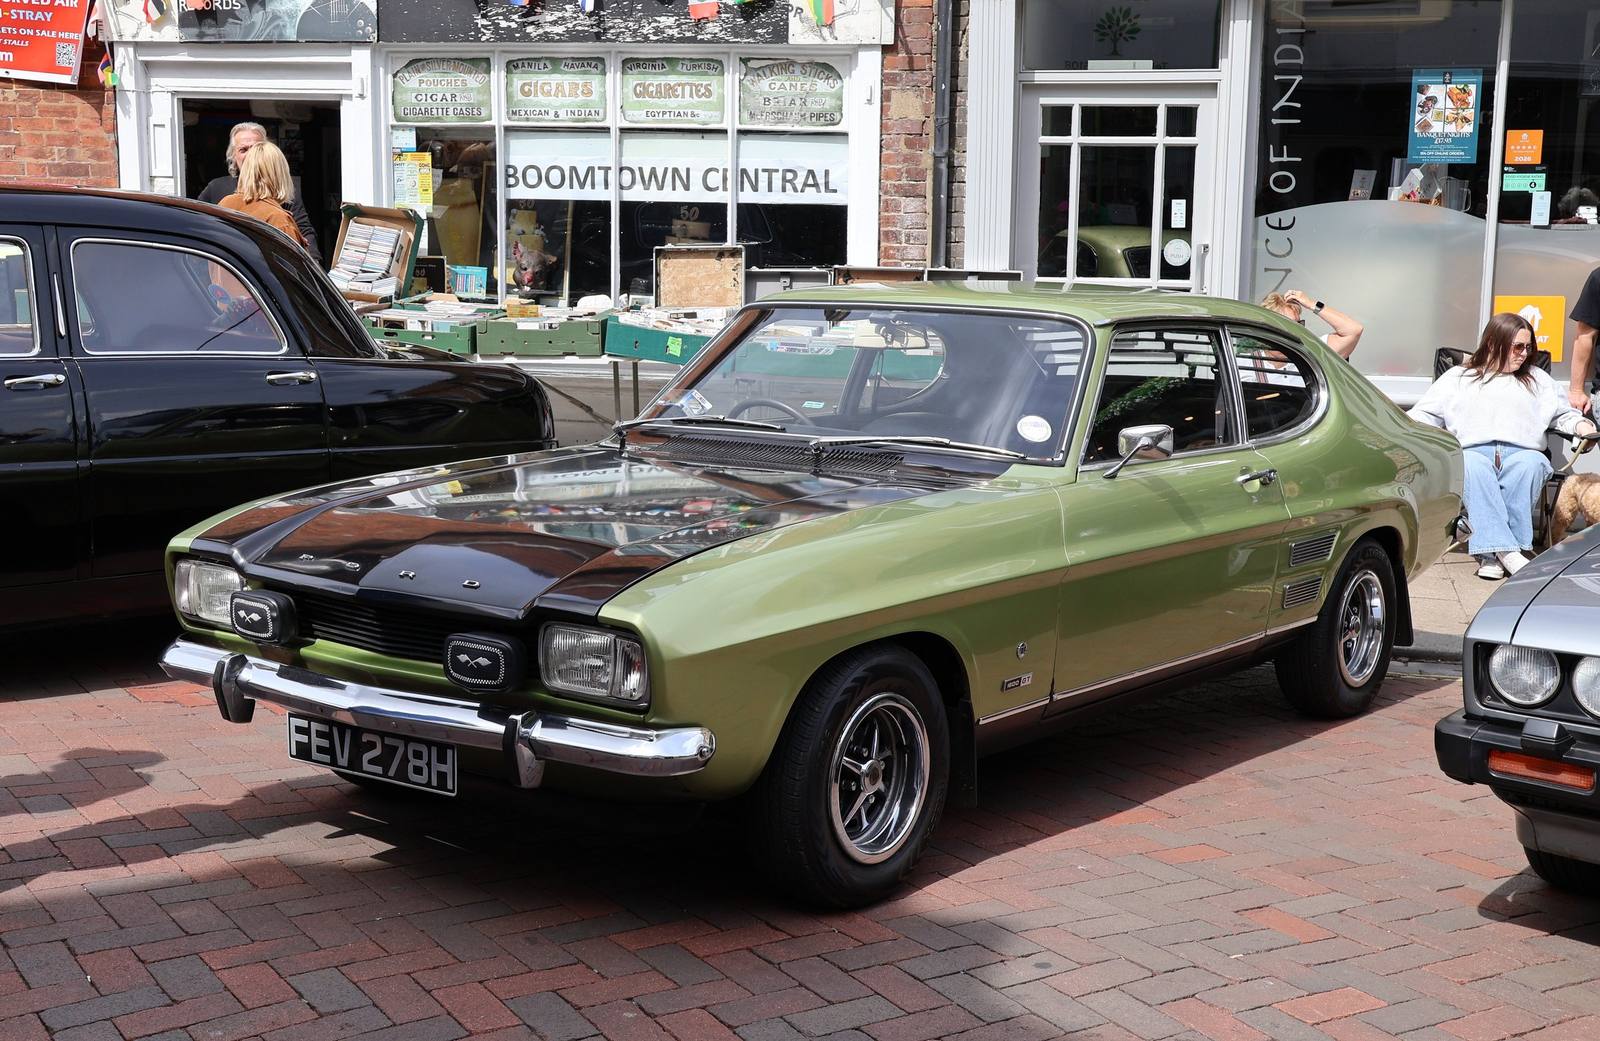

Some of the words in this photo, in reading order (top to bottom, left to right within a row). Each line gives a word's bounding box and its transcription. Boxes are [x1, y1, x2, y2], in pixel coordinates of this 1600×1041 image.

[180, 0, 241, 12] RORDS
[0, 26, 17, 35] ETS
[19, 28, 34, 36] ON
[36, 29, 57, 38] SALE
[4, 39, 29, 47] STALLS
[512, 61, 549, 71] MANILA
[562, 61, 600, 71] HAVANA
[626, 62, 668, 72] VIRGINIA
[680, 62, 719, 73] TURKISH
[398, 64, 422, 85] PLAIN
[748, 63, 796, 88] WALKING
[799, 63, 839, 89] STICKS
[418, 78, 469, 87] POUCHES
[519, 80, 594, 98] CIGARS
[633, 81, 713, 99] CIGARETTES
[414, 93, 458, 102] CIGAR
[403, 107, 450, 116] CIGARETTE
[452, 107, 482, 116] CASES
[511, 109, 549, 117] MEXICAN
[553, 110, 560, 119] &
[565, 109, 600, 117] INDIAN
[645, 110, 689, 118] EGYPTIAN
[809, 112, 836, 122] PIPES
[1269, 144, 1303, 194] OF
[505, 164, 691, 192] BOOMTOWN
[1535, 335, 1550, 344] AT
[299, 553, 481, 590] FORD
[1021, 676, 1031, 684] GT
[289, 716, 352, 768] FEV
[361, 732, 454, 791] 278H
